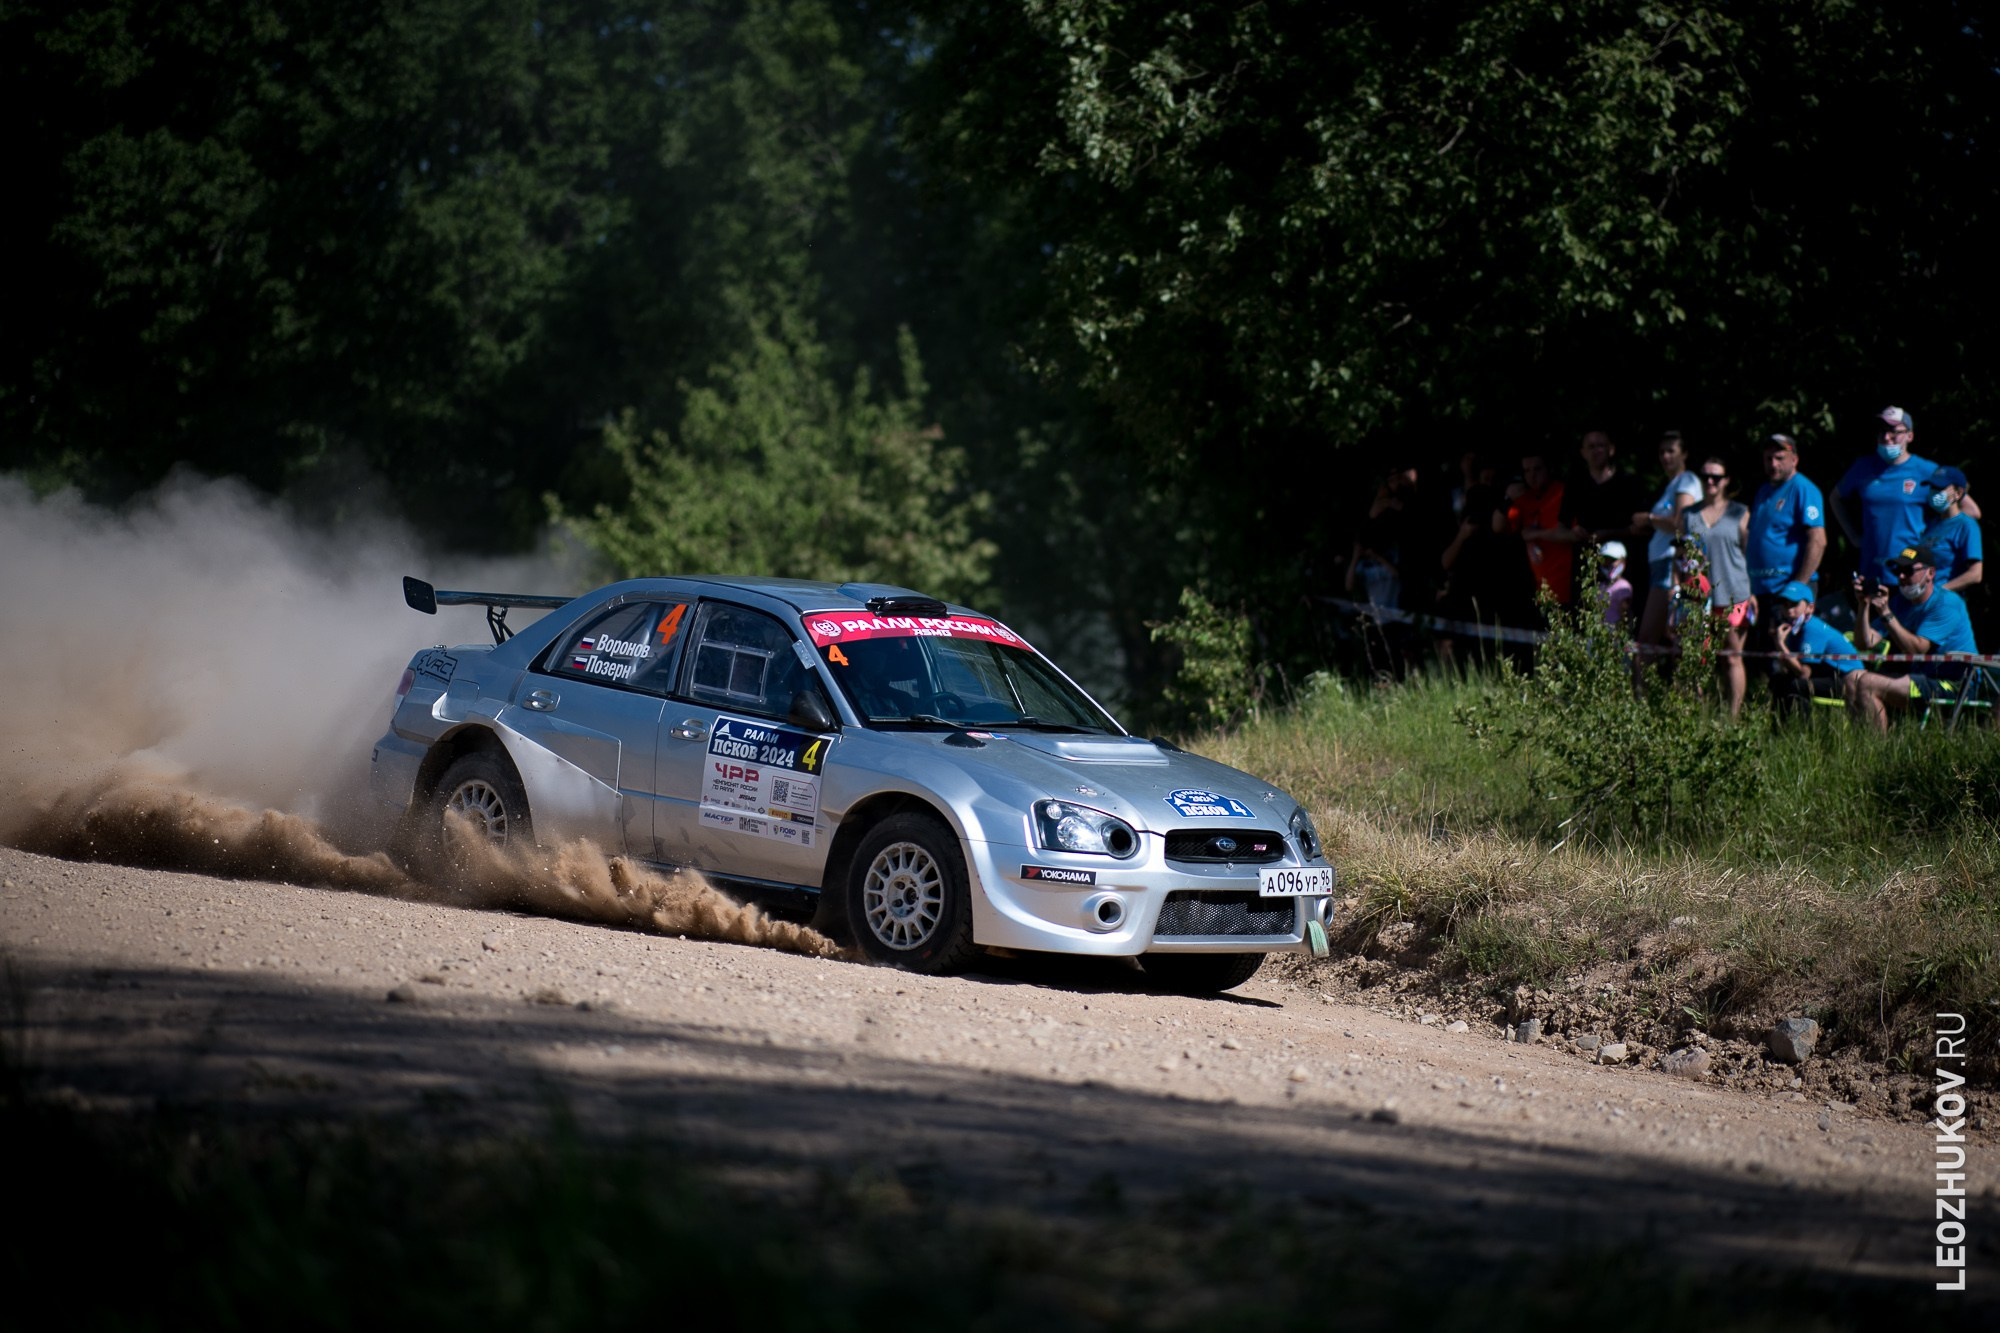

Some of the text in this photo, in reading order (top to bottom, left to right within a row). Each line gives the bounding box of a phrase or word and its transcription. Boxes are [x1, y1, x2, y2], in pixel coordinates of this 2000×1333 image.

[657, 604, 687, 645] 4
[841, 617, 997, 637] РАЛЛИ РОССИИ
[596, 633, 651, 658] Воронов
[828, 644, 849, 667] 4
[424, 656, 453, 675] VRC
[585, 654, 632, 681] Позерн
[743, 728, 780, 744] РАЛЛИ
[712, 738, 795, 768] ПСКОВ 2024
[802, 740, 822, 771] 4
[715, 762, 760, 783] ЧРР
[704, 812, 734, 821] МАСТЕР
[1179, 805, 1230, 816] ПСКОВ
[1229, 800, 1248, 816] 4
[1040, 869, 1091, 882] YOKOHAMA
[1320, 869, 1330, 886] 96
